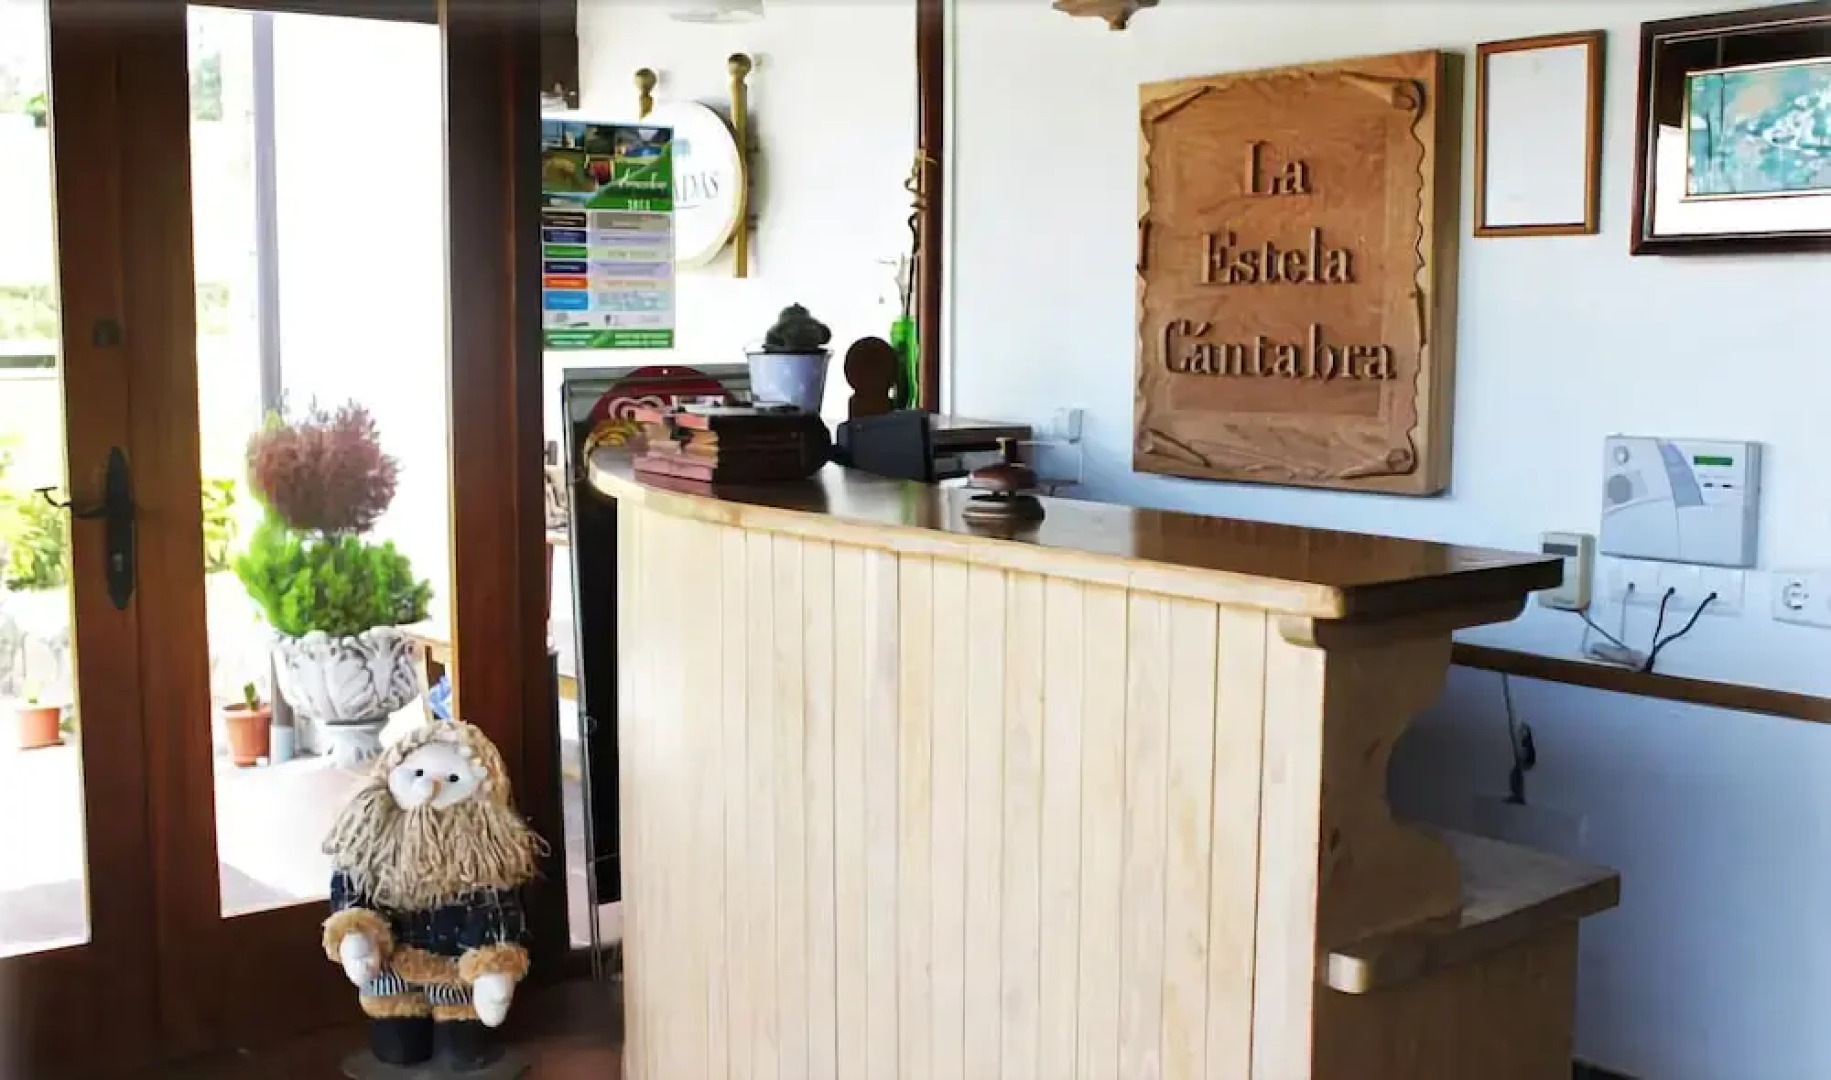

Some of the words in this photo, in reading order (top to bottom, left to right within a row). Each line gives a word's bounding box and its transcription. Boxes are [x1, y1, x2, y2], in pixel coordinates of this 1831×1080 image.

[1245, 140, 1312, 196] La
[1200, 227, 1356, 284] Estela
[1160, 318, 1398, 380] Cántabra
